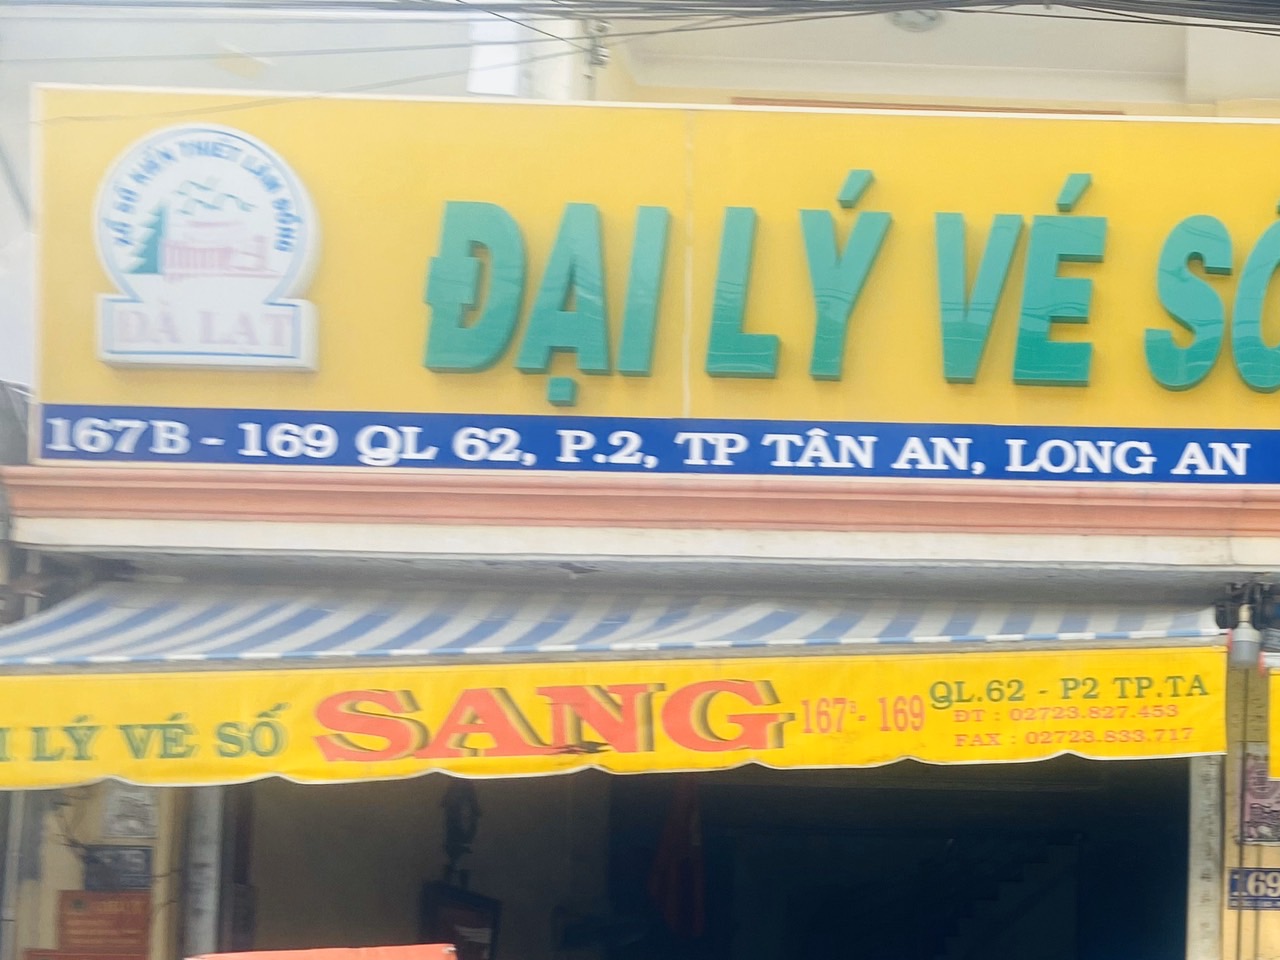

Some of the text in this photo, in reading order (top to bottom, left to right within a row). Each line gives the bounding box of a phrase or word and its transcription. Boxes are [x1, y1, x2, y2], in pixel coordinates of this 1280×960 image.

[425, 200, 670, 406] ĐẠI
[705, 169, 893, 381] LÝ
[935, 173, 1108, 386] VÉ
[46, 417, 191, 454] 167B
[238, 421, 339, 458] 169
[355, 424, 439, 466] QL
[452, 426, 537, 466] 62,
[555, 430, 659, 469] P.2,
[674, 431, 748, 466] TP
[762, 428, 878, 470] TÂN
[891, 438, 987, 475] AN,
[1005, 439, 1157, 474] LONG
[1171, 443, 1251, 476] AN
[32, 714, 102, 762] LÝ
[118, 712, 200, 760] VÉ
[215, 702, 288, 759] SỐ
[314, 677, 795, 763] SANG
[878, 694, 927, 733] 169
[1061, 677, 1099, 700] P2
